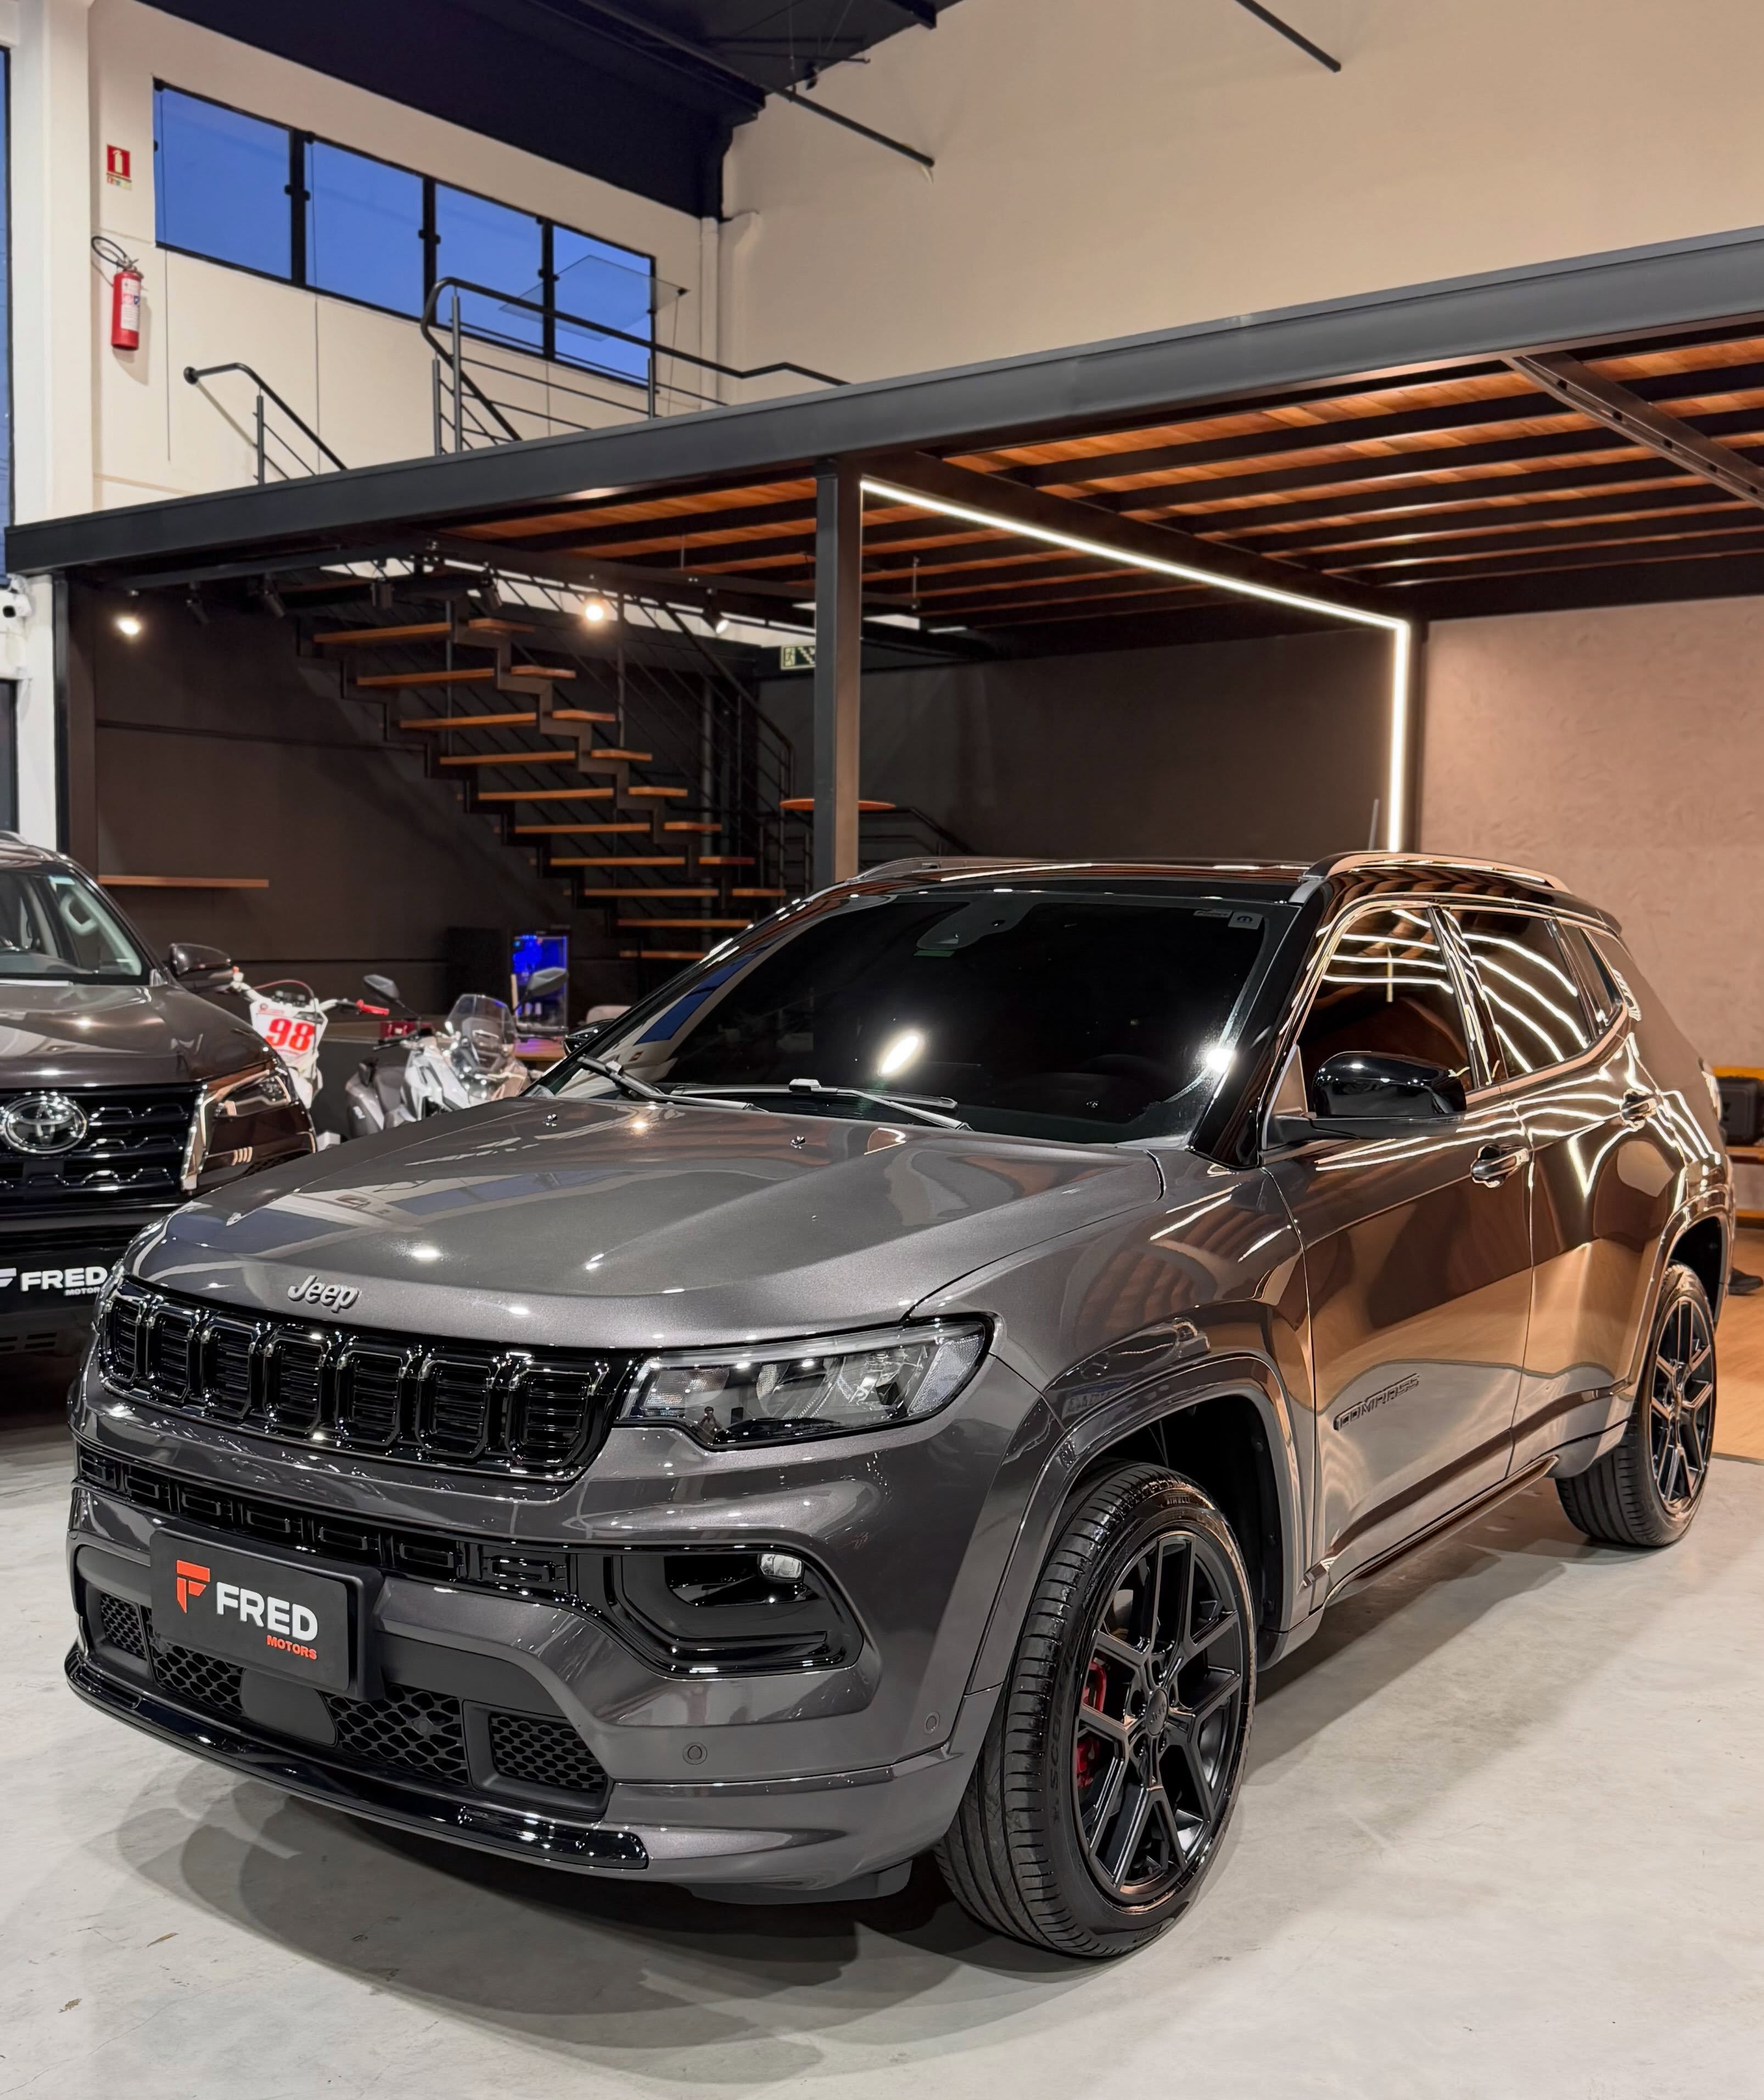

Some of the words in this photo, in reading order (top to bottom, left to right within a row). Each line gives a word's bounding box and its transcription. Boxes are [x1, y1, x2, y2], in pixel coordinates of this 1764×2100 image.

[265, 1018, 316, 1051] 98
[21, 1266, 108, 1292] FRED
[65, 1286, 101, 1296] MOTOR
[288, 1275, 361, 1313] Jeep
[1333, 1373, 1420, 1431] COMPASS
[216, 1581, 318, 1641] FRED
[266, 1635, 317, 1660] MOTORS
